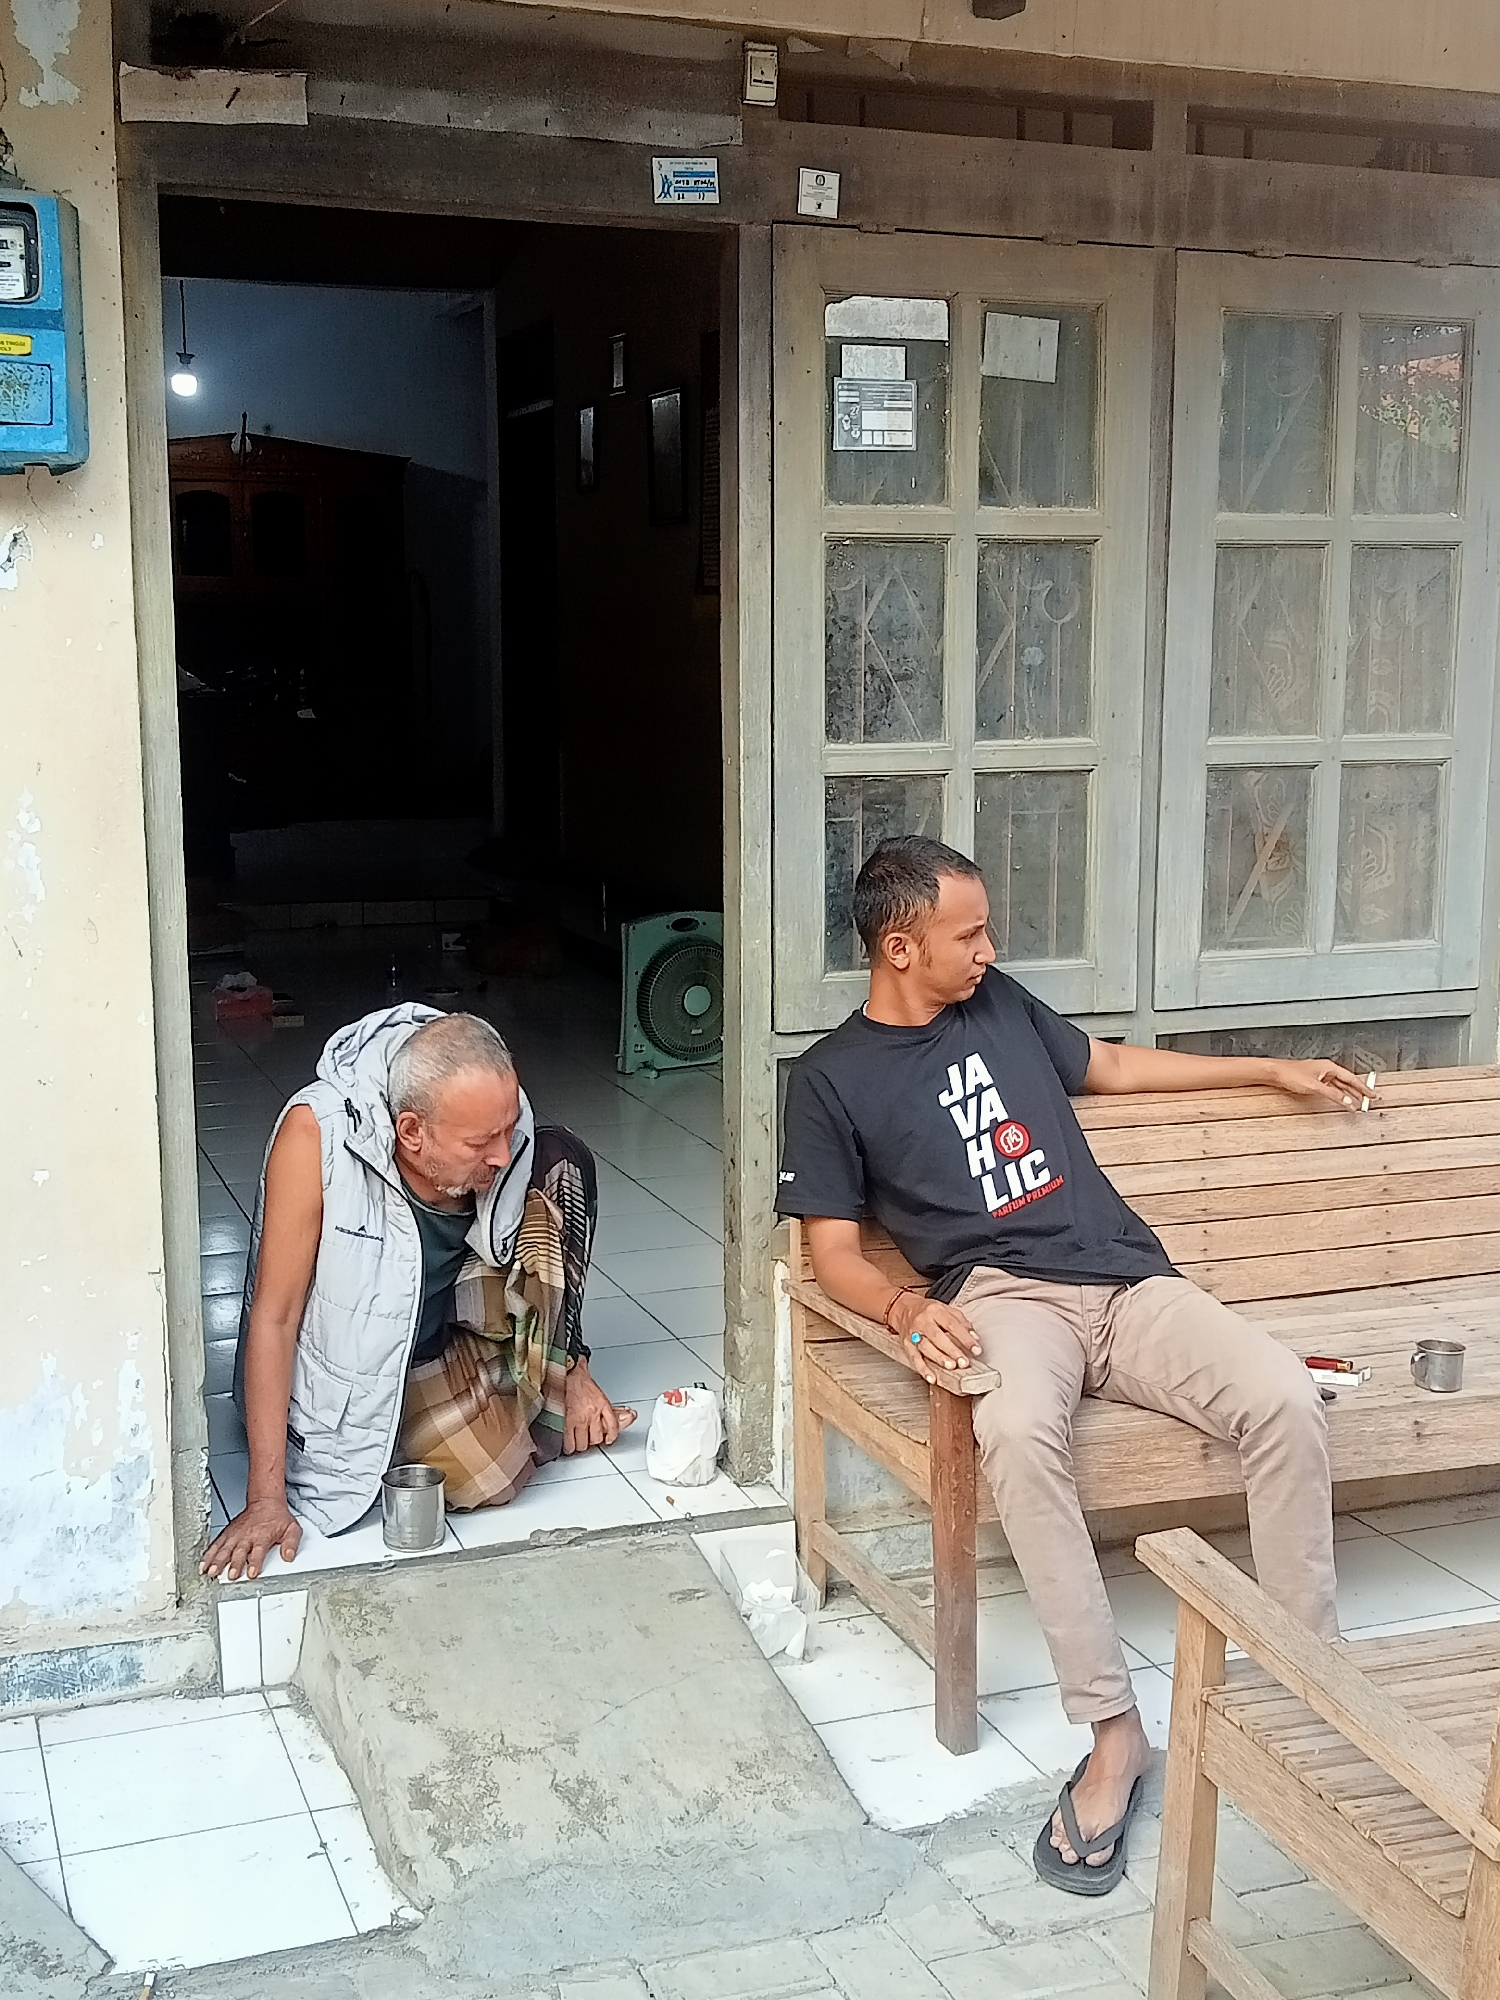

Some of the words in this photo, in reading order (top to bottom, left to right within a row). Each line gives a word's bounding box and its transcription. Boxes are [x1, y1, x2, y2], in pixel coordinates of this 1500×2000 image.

[981, 1148, 1052, 1213] LIC
[991, 1196, 1026, 1219] PARFUM
[1025, 1174, 1065, 1203] PREMIUM
